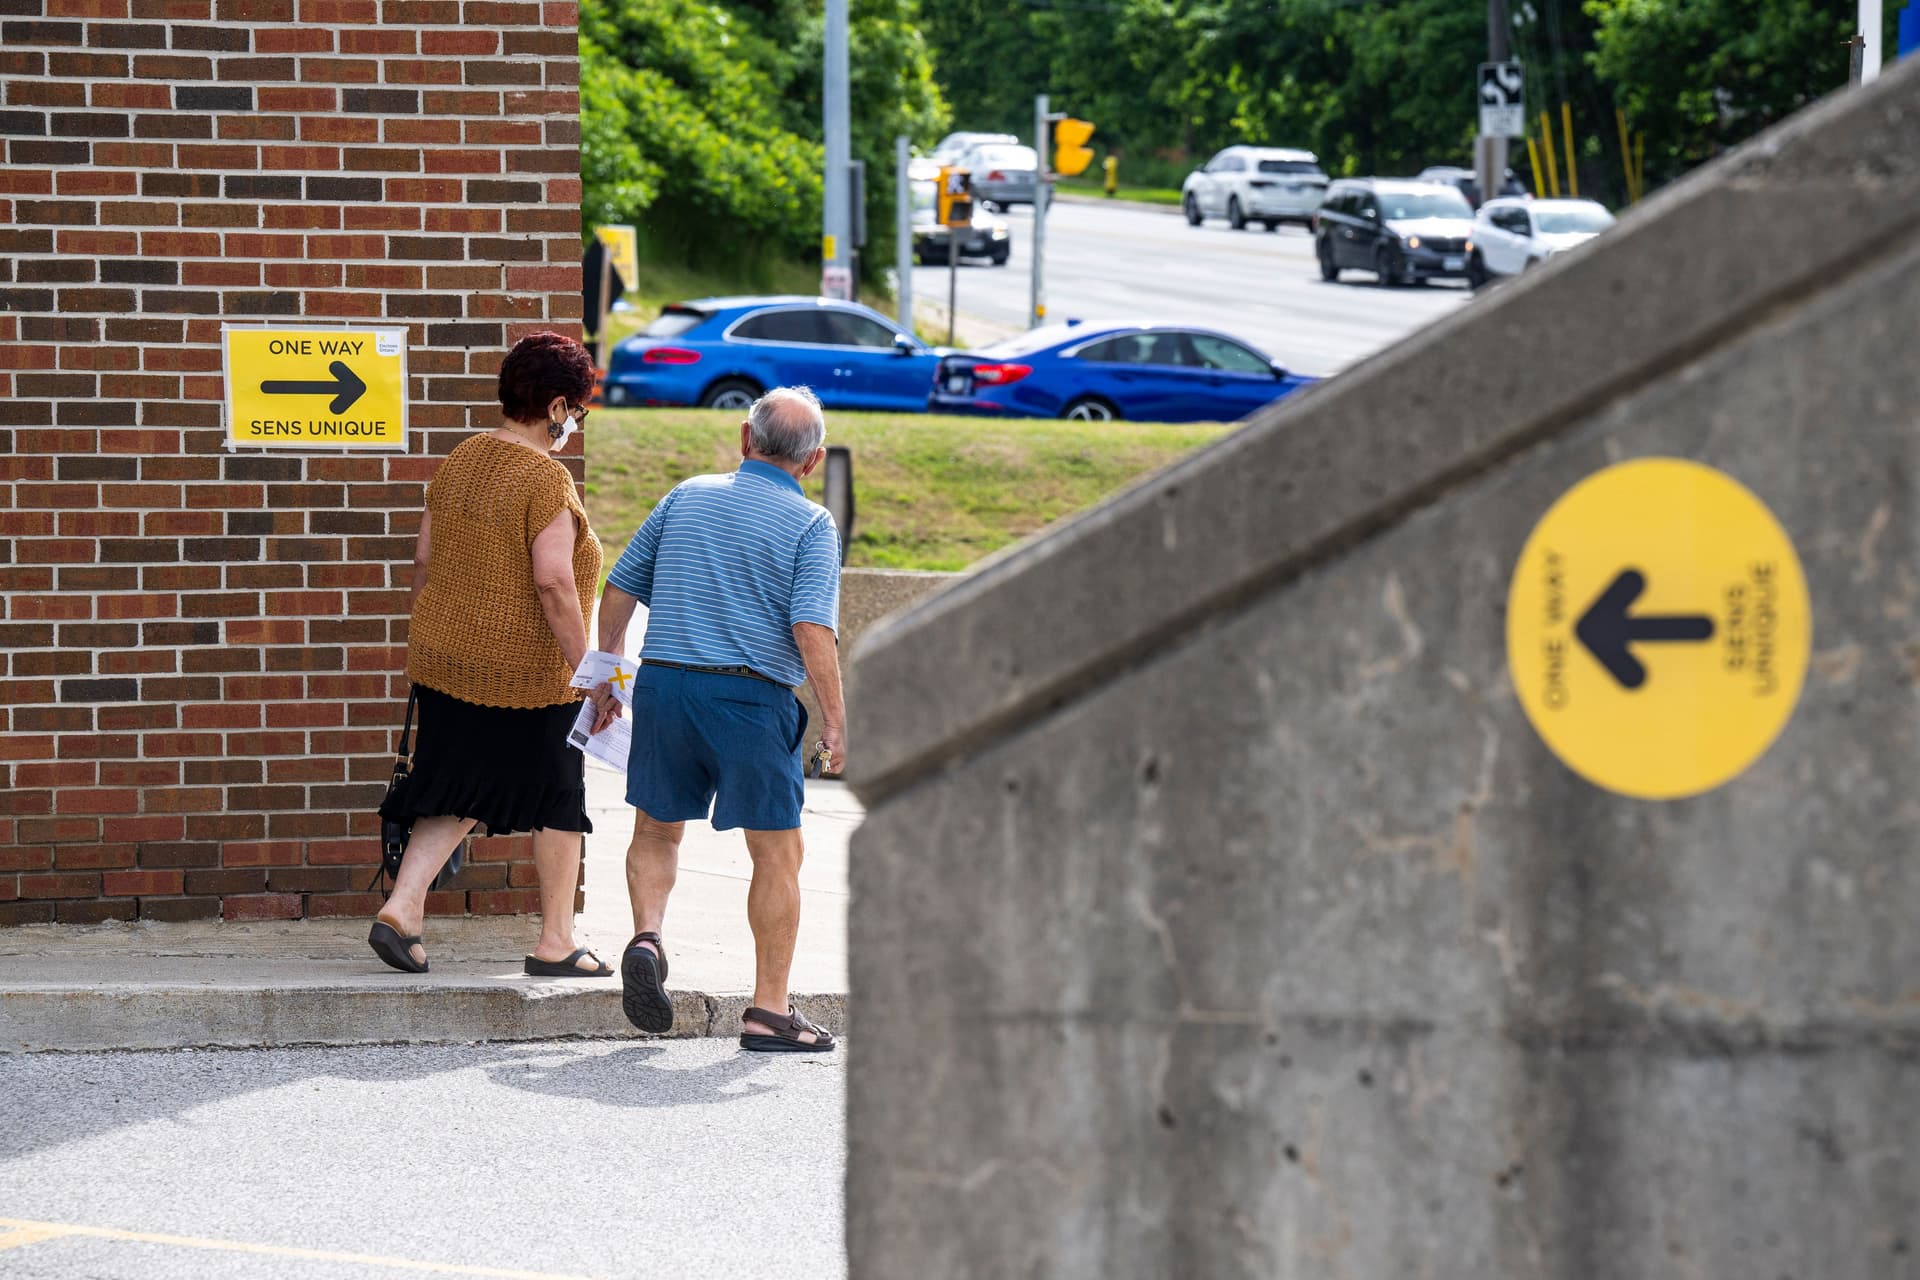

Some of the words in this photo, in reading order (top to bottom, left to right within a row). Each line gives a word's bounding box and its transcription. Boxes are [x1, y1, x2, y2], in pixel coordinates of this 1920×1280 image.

[269, 340, 312, 355] ONE
[319, 341, 364, 355] WAY
[251, 420, 302, 435] SENS
[309, 421, 386, 436] UNIQUE
[1544, 548, 1564, 622] WAY
[1727, 587, 1746, 671] SENS
[1752, 562, 1777, 698] UNIQUE
[1543, 640, 1566, 711] ONE
